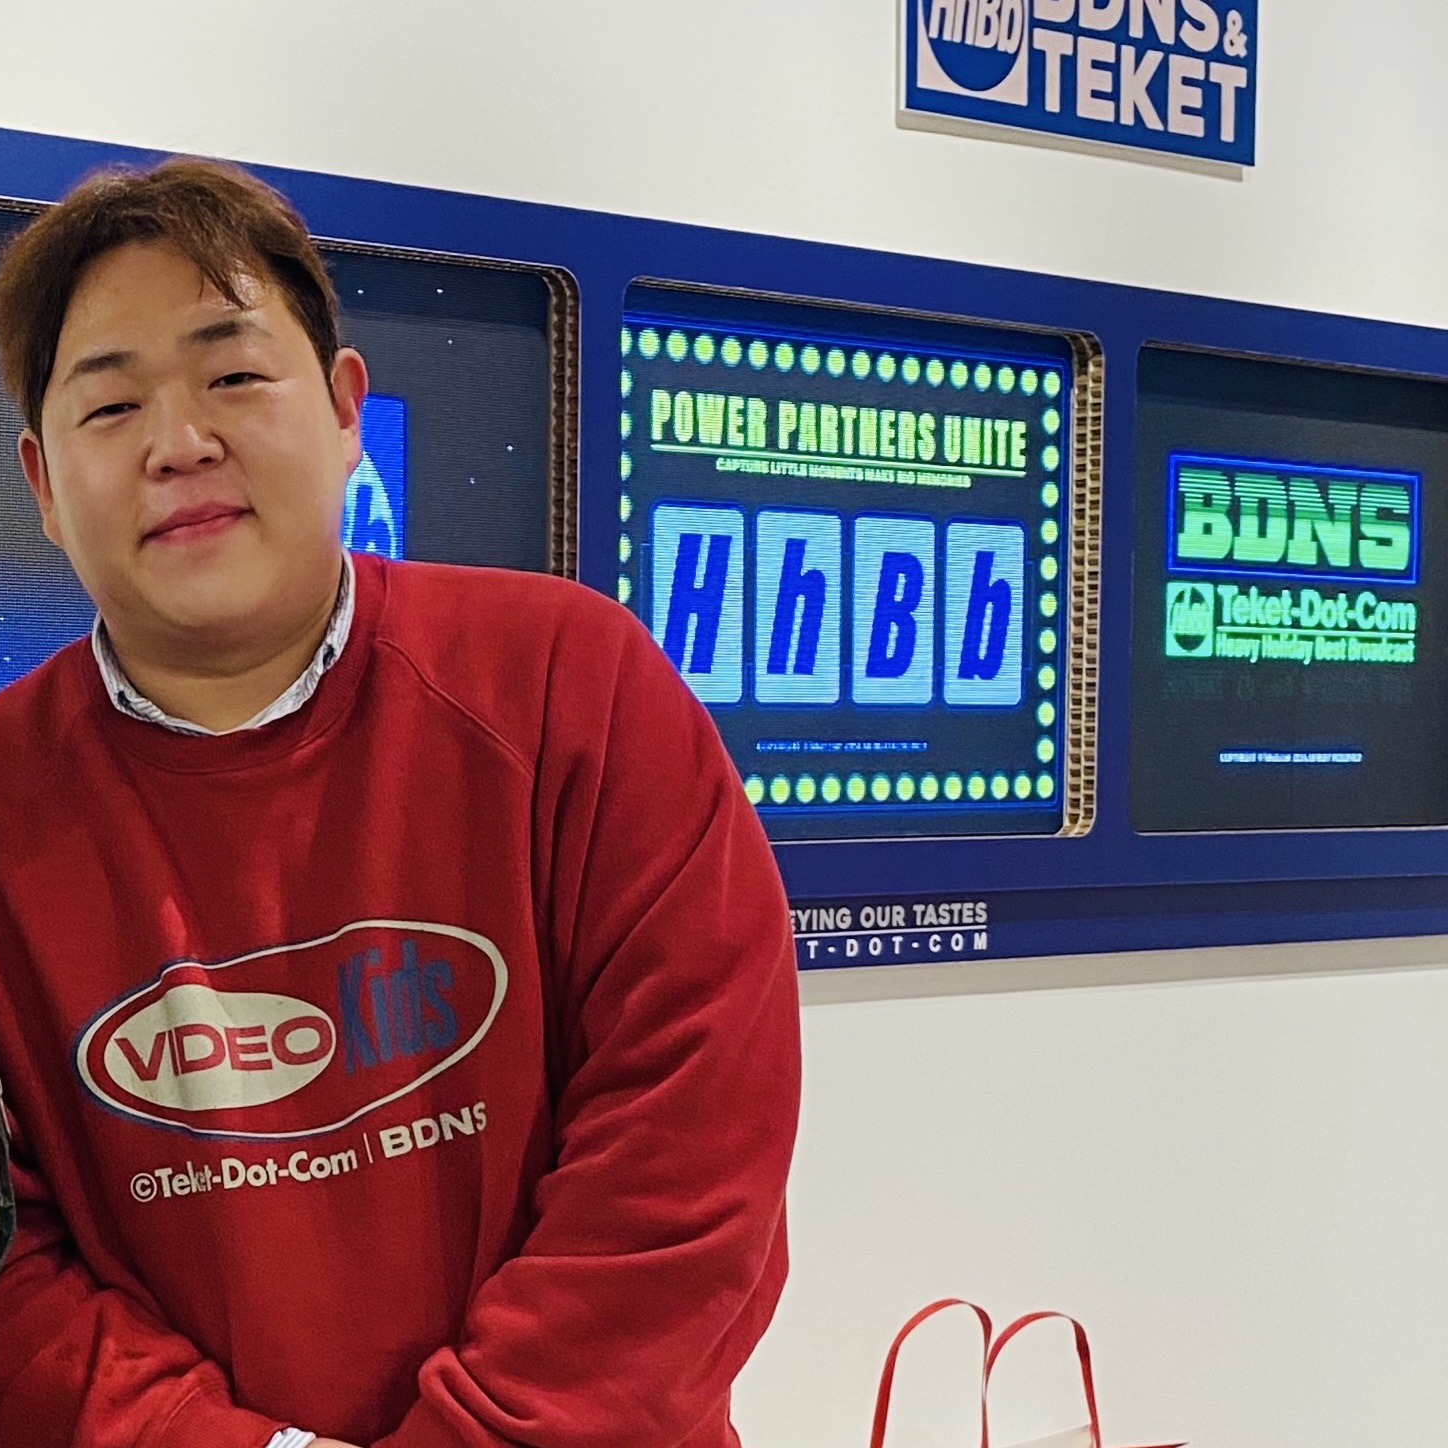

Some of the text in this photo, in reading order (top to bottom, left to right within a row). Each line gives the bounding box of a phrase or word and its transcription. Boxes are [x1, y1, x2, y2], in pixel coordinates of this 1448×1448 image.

[1033, 28, 1248, 143] TEKET
[652, 389, 1027, 468] POWER PARTNERS UNITE
[1177, 468, 1411, 571] BDNS
[1216, 585, 1416, 631] Teket-Dot-Com
[860, 905, 906, 928] OUR
[913, 902, 988, 926] TASTES
[338, 939, 458, 1076] Kids
[379, 1101, 487, 1158] BDNS
